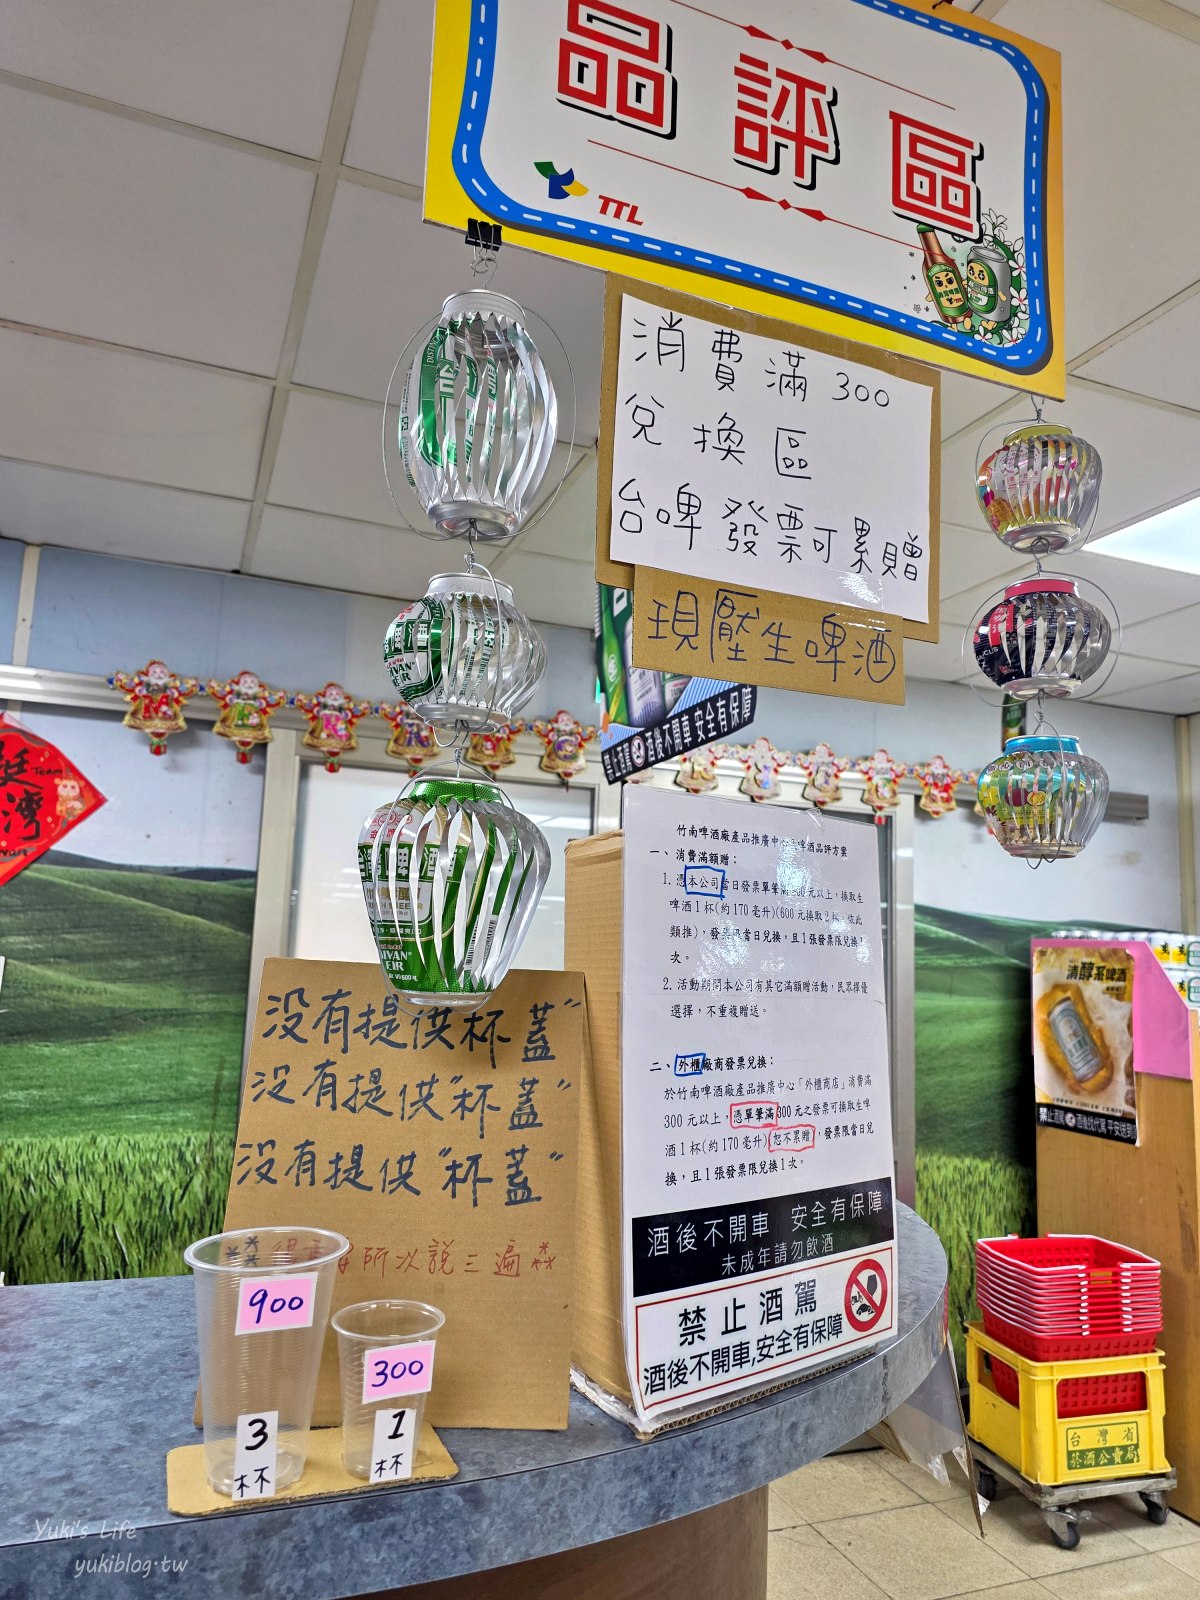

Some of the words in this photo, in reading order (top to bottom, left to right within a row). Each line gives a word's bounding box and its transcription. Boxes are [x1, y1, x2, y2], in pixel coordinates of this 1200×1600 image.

[556, 0, 983, 243] 品評區
[597, 193, 644, 225] TTL
[624, 392, 812, 480] 兌換區
[617, 477, 923, 582] 台啤發票可累贈
[647, 587, 896, 683] 現壓生啤酒
[694, 686, 753, 743] 安全有保障
[677, 823, 848, 859] 竹南啤酒廠產品推廣中啤酒品評方案
[647, 1211, 770, 1257] 酒後不開車
[791, 1189, 883, 1232] 安全有保障
[721, 1232, 834, 1276] 未成年請勿飲酒
[248, 1288, 304, 1324] 900
[678, 1278, 817, 1347] 禁止酒駕
[371, 1359, 424, 1388] 300
[244, 1417, 269, 1451] 3
[387, 1409, 406, 1441] 1
[1070, 1426, 1134, 1448] 台灣省
[374, 1453, 404, 1478] 杯
[1069, 1445, 1138, 1468] 菸酒公賣局
[233, 1466, 271, 1498] 杯
